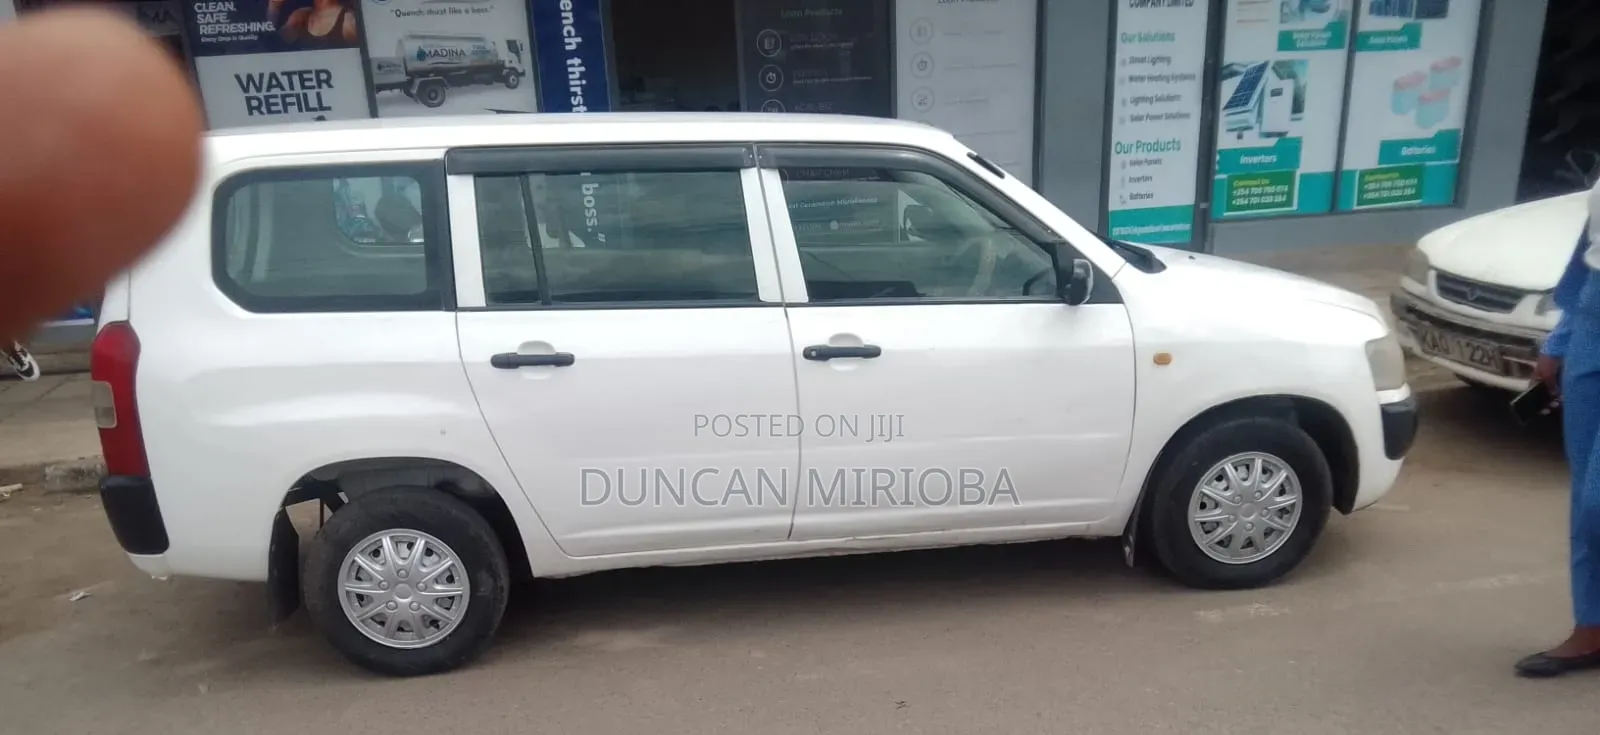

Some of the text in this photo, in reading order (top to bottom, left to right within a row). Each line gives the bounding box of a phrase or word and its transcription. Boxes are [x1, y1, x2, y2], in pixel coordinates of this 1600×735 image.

[194, 2, 236, 12] CLEAN.
[199, 20, 276, 35] REFRESHING.
[234, 68, 334, 94] WATER
[244, 91, 332, 116] REFILL
[1115, 138, 1181, 154] Our Products
